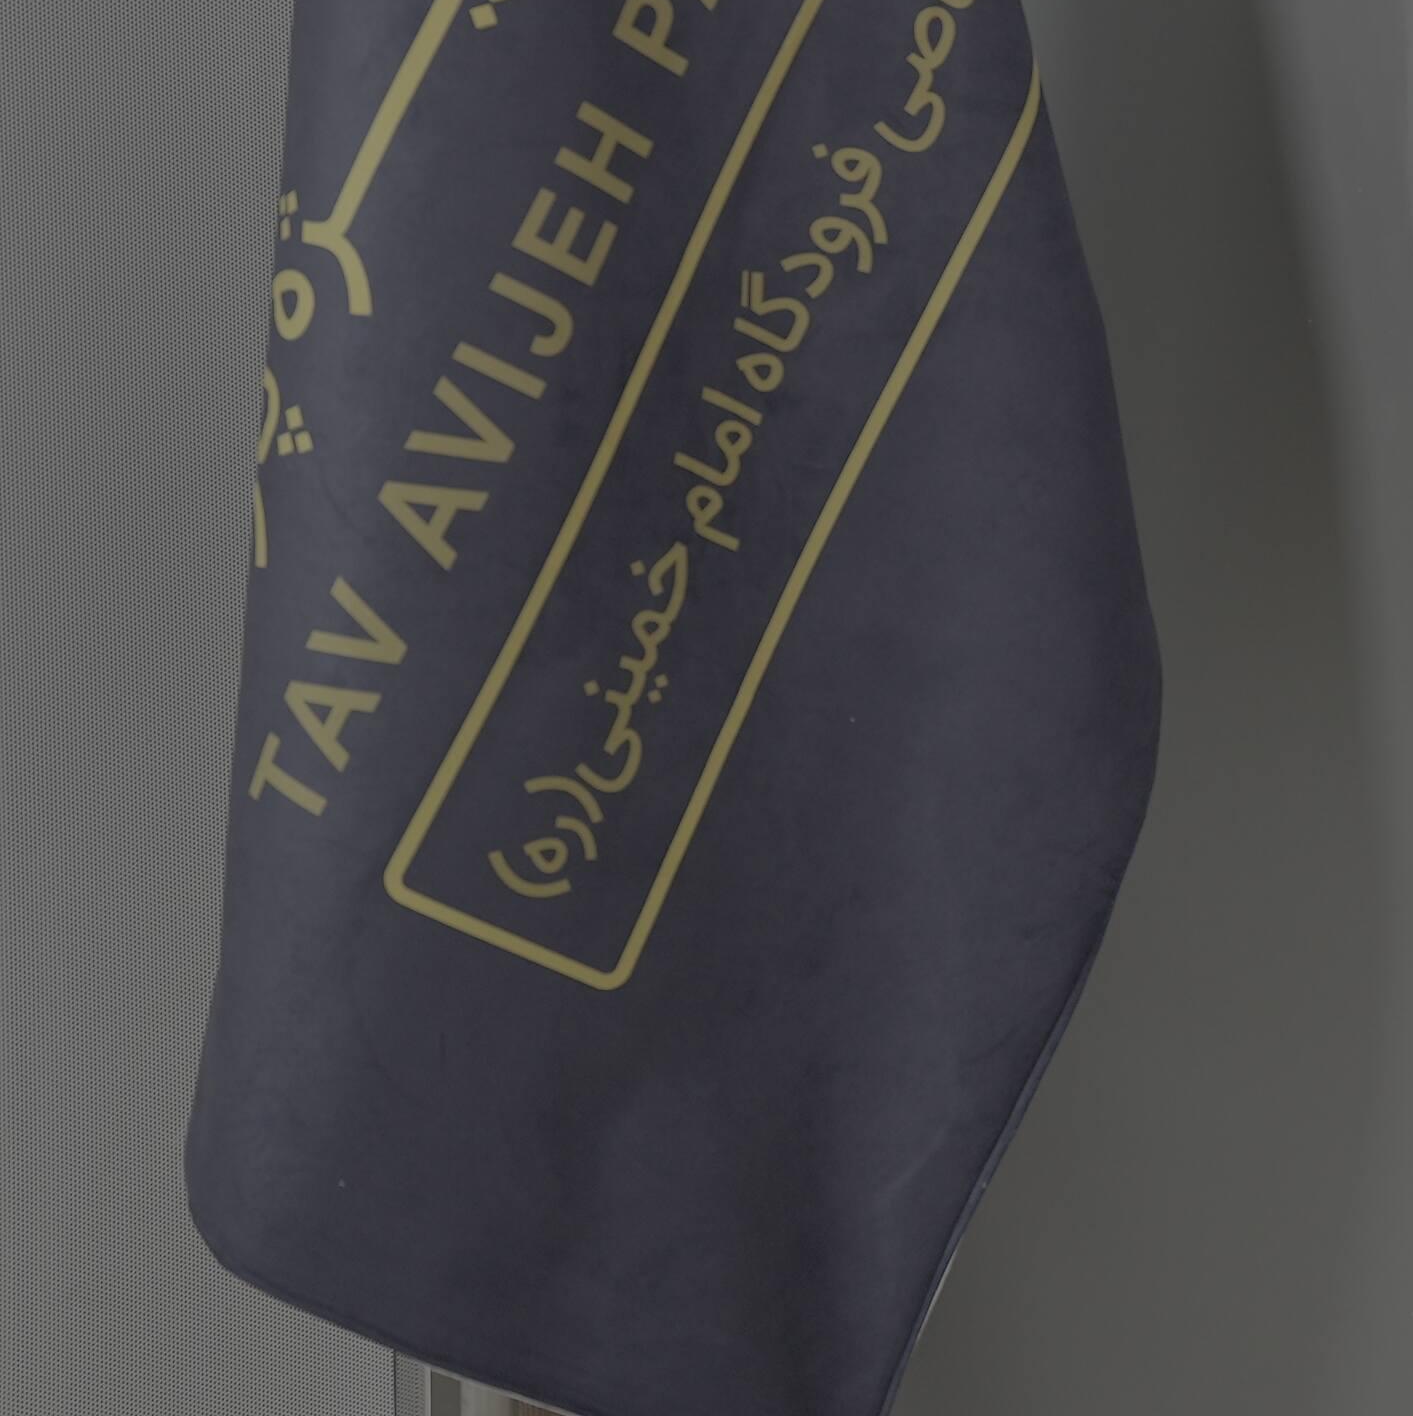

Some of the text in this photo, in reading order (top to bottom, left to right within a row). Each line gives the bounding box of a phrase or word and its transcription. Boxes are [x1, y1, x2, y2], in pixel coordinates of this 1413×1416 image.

[735, 144, 889, 393] فرودگاه
[250, 578, 407, 815] TAV
[378, 102, 653, 568] AVIJEH
[674, 387, 763, 551] امام
